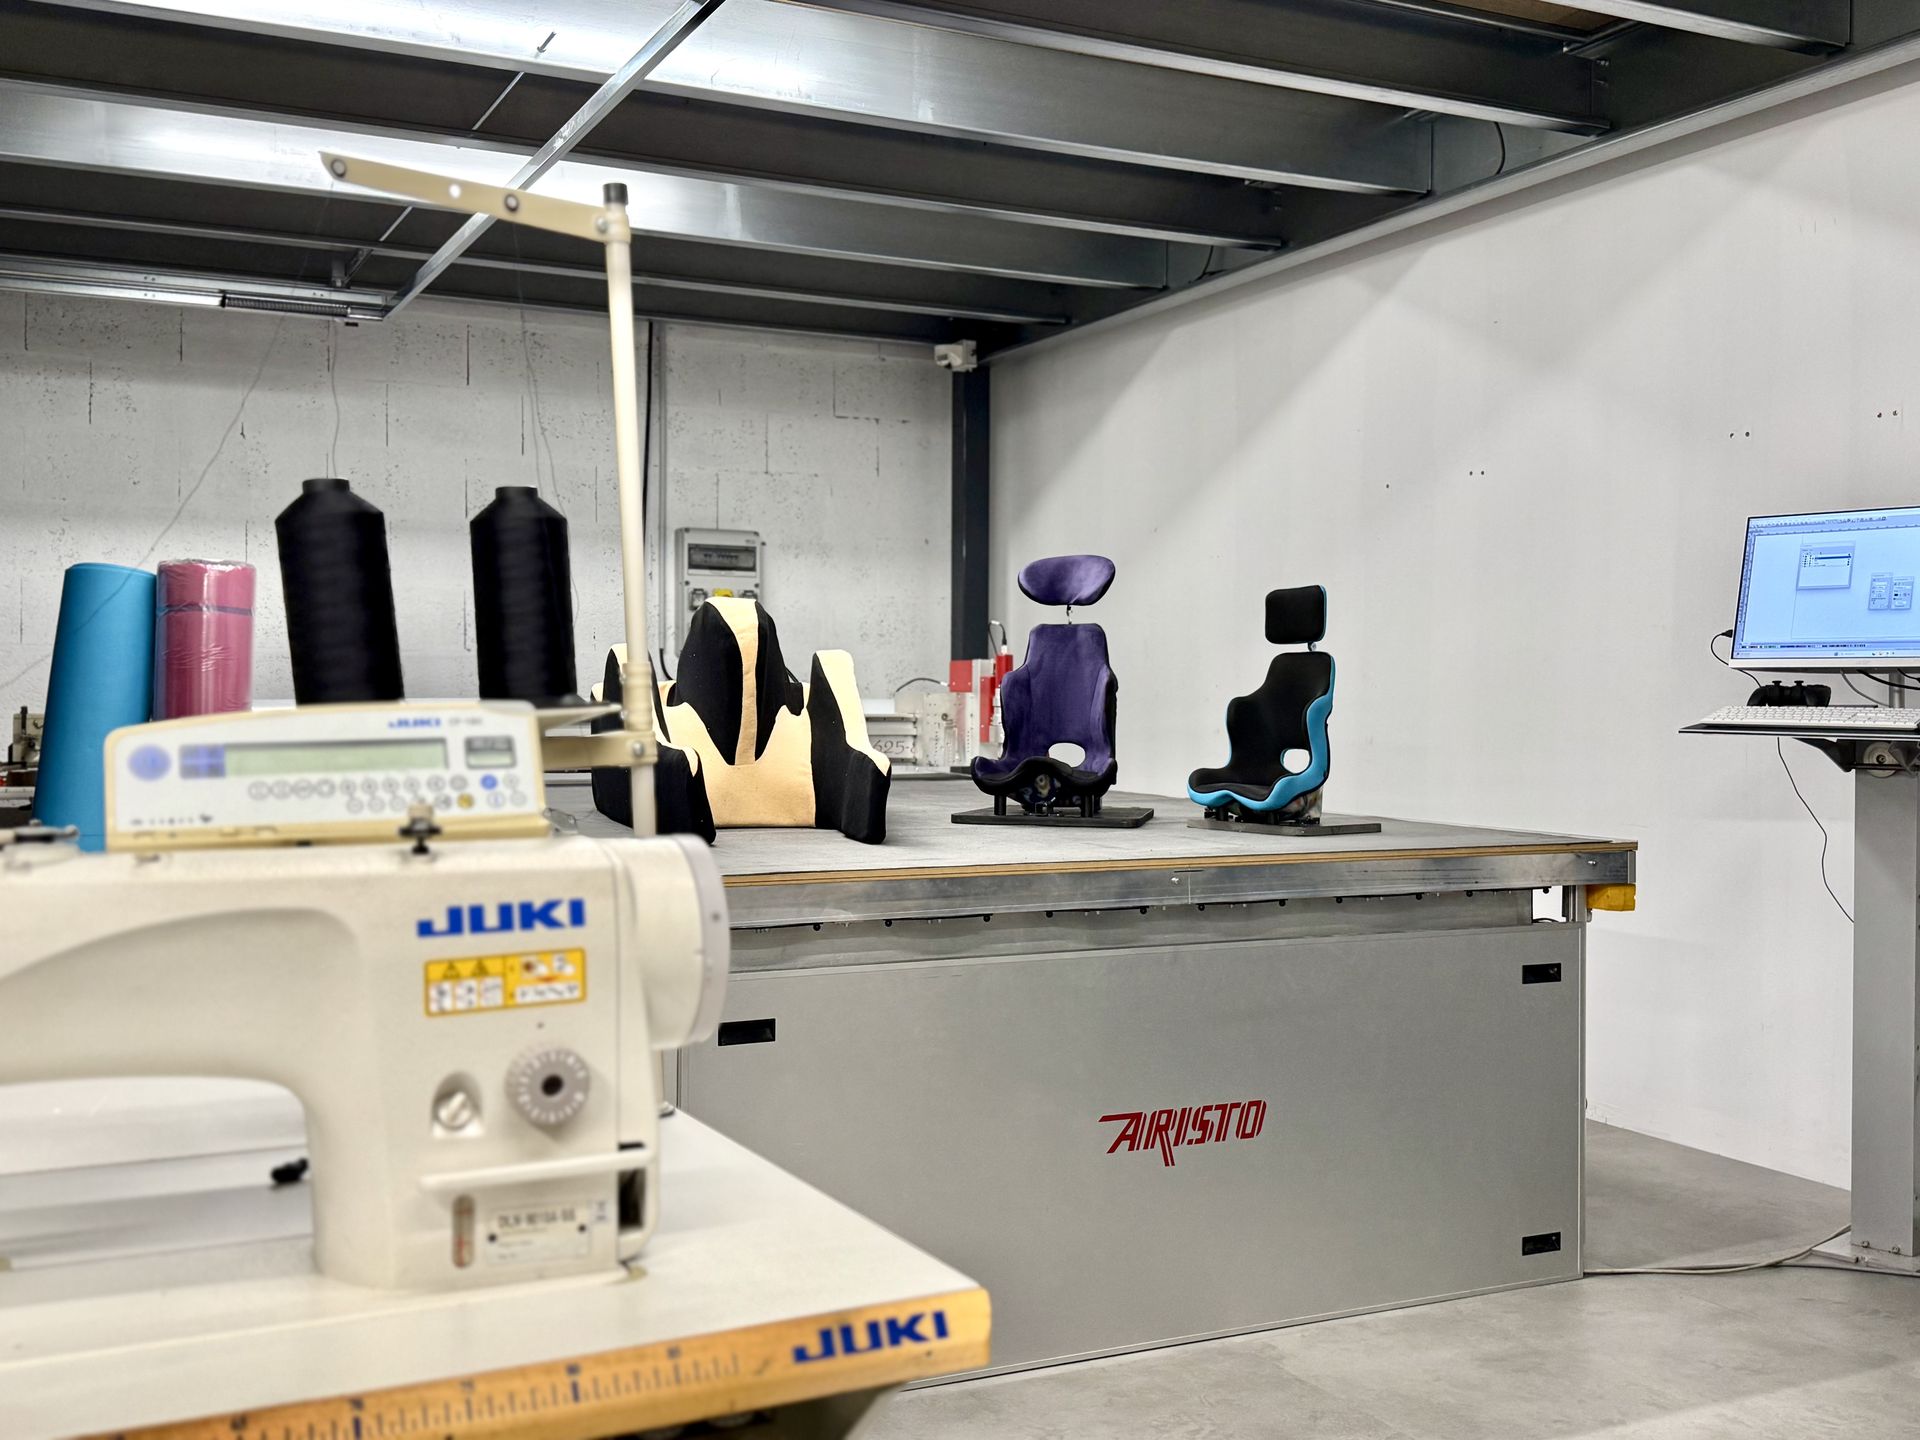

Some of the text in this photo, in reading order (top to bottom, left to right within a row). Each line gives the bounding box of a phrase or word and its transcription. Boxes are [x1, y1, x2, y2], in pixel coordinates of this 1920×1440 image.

[417, 899, 586, 938] JUKI
[1097, 1099, 1267, 1167] ARISTO
[793, 1311, 949, 1363] JUKI
